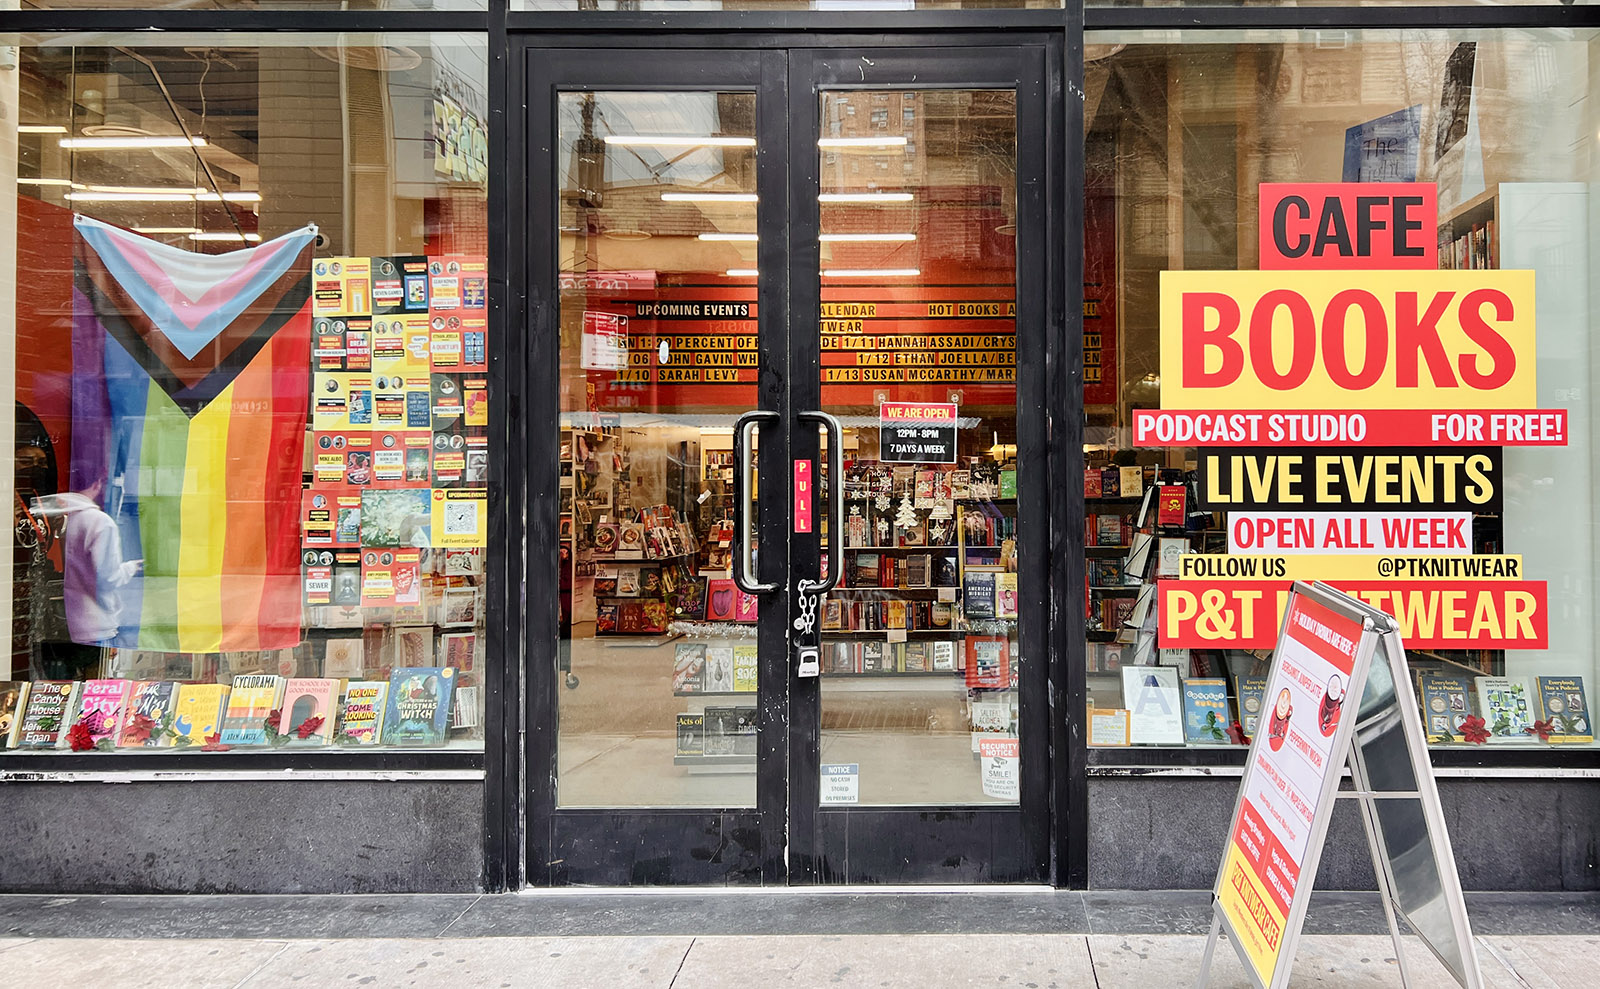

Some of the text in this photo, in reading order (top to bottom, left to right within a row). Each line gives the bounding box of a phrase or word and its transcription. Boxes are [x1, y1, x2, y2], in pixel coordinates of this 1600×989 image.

[1363, 137, 1398, 160] The
[1272, 195, 1425, 258] CAFE
[637, 304, 999, 316] UPCOMING EVENTS ALENDAR HOT BOOKS
[820, 321, 862, 332] TWEAR
[676, 337, 733, 348] PERCENT
[844, 337, 875, 348] 1/11
[878, 337, 927, 348] HANNAH
[929, 337, 1015, 348] ASSADI/CRYS
[1182, 289, 1516, 390] BOOKS
[695, 353, 733, 364] GAVIN
[738, 353, 757, 364] WH
[858, 354, 889, 364] 1/12
[895, 354, 935, 364] ETHAN
[941, 353, 1013, 364] JOELLA/BE
[618, 369, 1013, 380] 1/10 SARAH LEVY 1/13 SUSAN MCCARTHY/MAR
[887, 407, 950, 419] WE ARE OPEN
[896, 429, 917, 438] 12PM
[921, 429, 939, 438] 8PM
[1137, 413, 1563, 442] PODCAST STUDIO FOR FREE!
[890, 444, 946, 454] 7 DAYS A WEEK
[1206, 453, 1495, 505] LIVE EVENTS
[799, 462, 807, 530] PULL
[1233, 518, 1467, 549] OPEN ALL WEEK
[1183, 558, 1518, 578] FOLLOW US @PTKNITWEAR
[1167, 589, 1538, 640] P&T TWEAR
[1338, 635, 1353, 657] HERE
[43, 683, 60, 693] The
[84, 681, 122, 694] Feral
[233, 676, 275, 689] CYCLORAMA
[349, 688, 378, 698] NO ONE
[1134, 675, 1173, 715] A
[33, 694, 65, 706] Candy
[136, 695, 167, 715] Miss
[397, 702, 438, 710] CHRISTMAS
[30, 704, 61, 715] House
[80, 697, 120, 716] City
[347, 704, 371, 712] COME
[345, 711, 377, 720] LOOKING
[401, 710, 433, 719] WITCH
[679, 716, 703, 725] Acts of
[25, 732, 51, 744] Egan
[828, 766, 850, 774] NOTICE
[988, 770, 1011, 778] SMILE!
